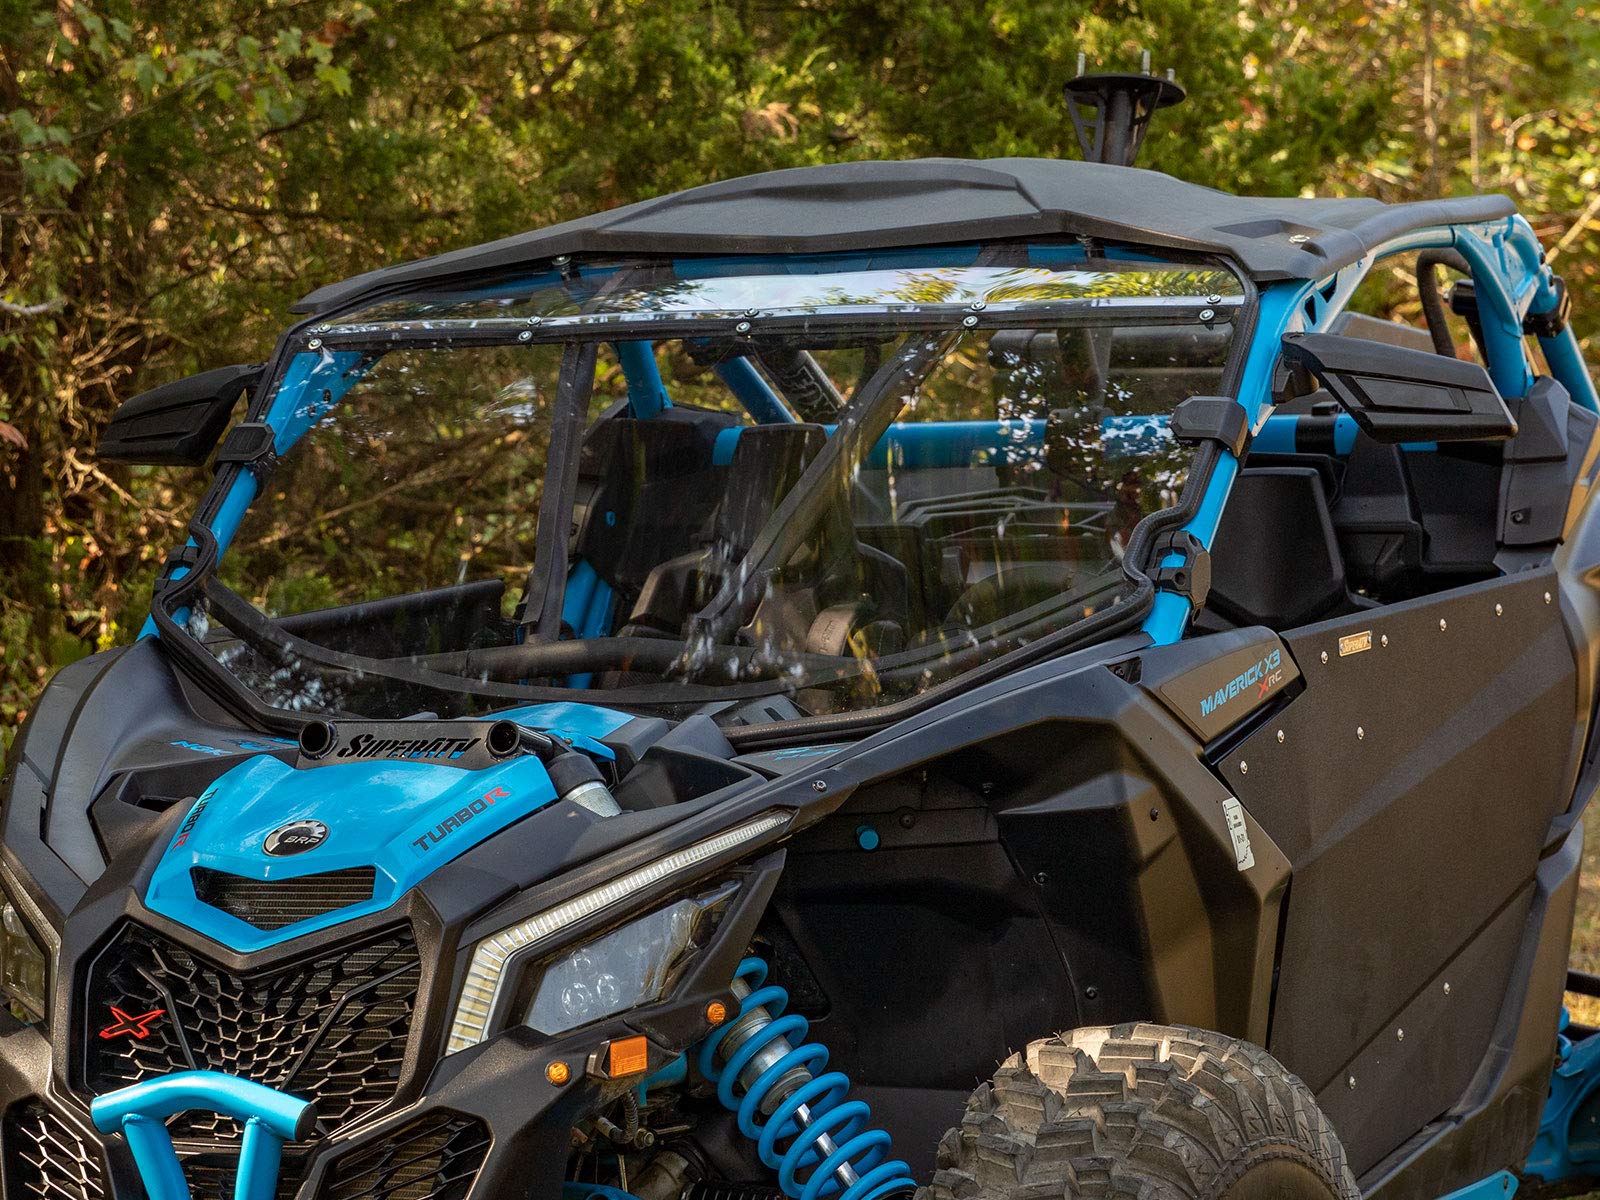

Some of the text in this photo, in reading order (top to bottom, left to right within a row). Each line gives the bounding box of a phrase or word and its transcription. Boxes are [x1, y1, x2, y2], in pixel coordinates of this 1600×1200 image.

[1200, 648, 1281, 718] MAVERICK X3
[283, 835, 320, 847] BRP
